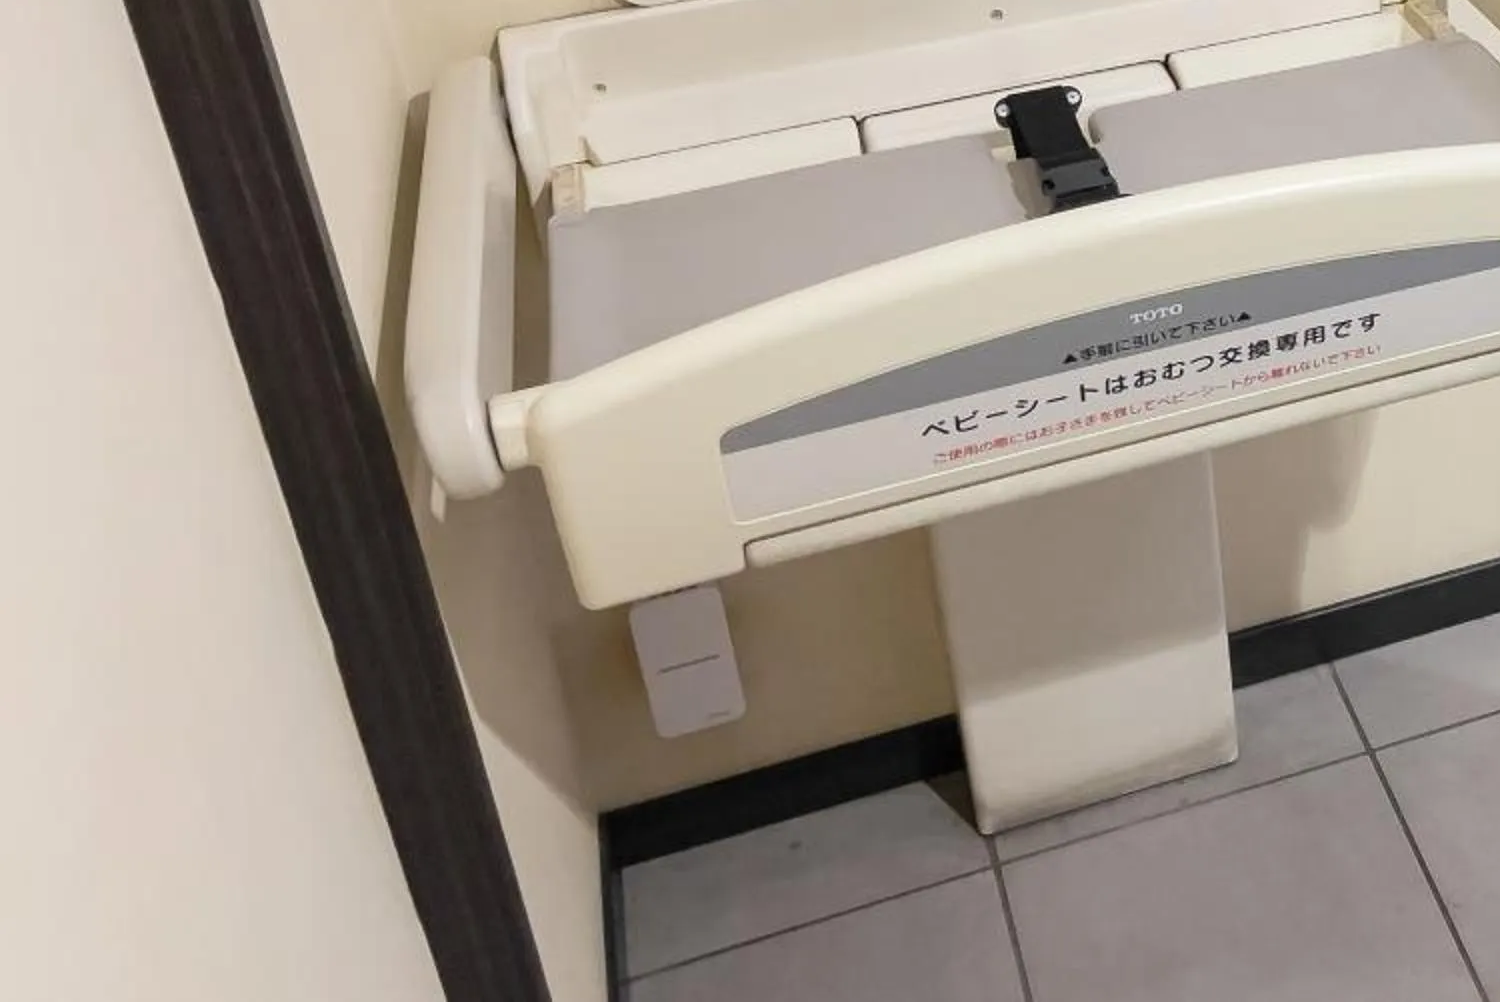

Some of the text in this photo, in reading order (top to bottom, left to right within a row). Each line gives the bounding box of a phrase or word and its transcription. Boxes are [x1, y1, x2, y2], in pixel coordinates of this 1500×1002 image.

[1129, 300, 1184, 326] TOTO
[919, 307, 1381, 445] ベビーシートはおむつ交換専用です
